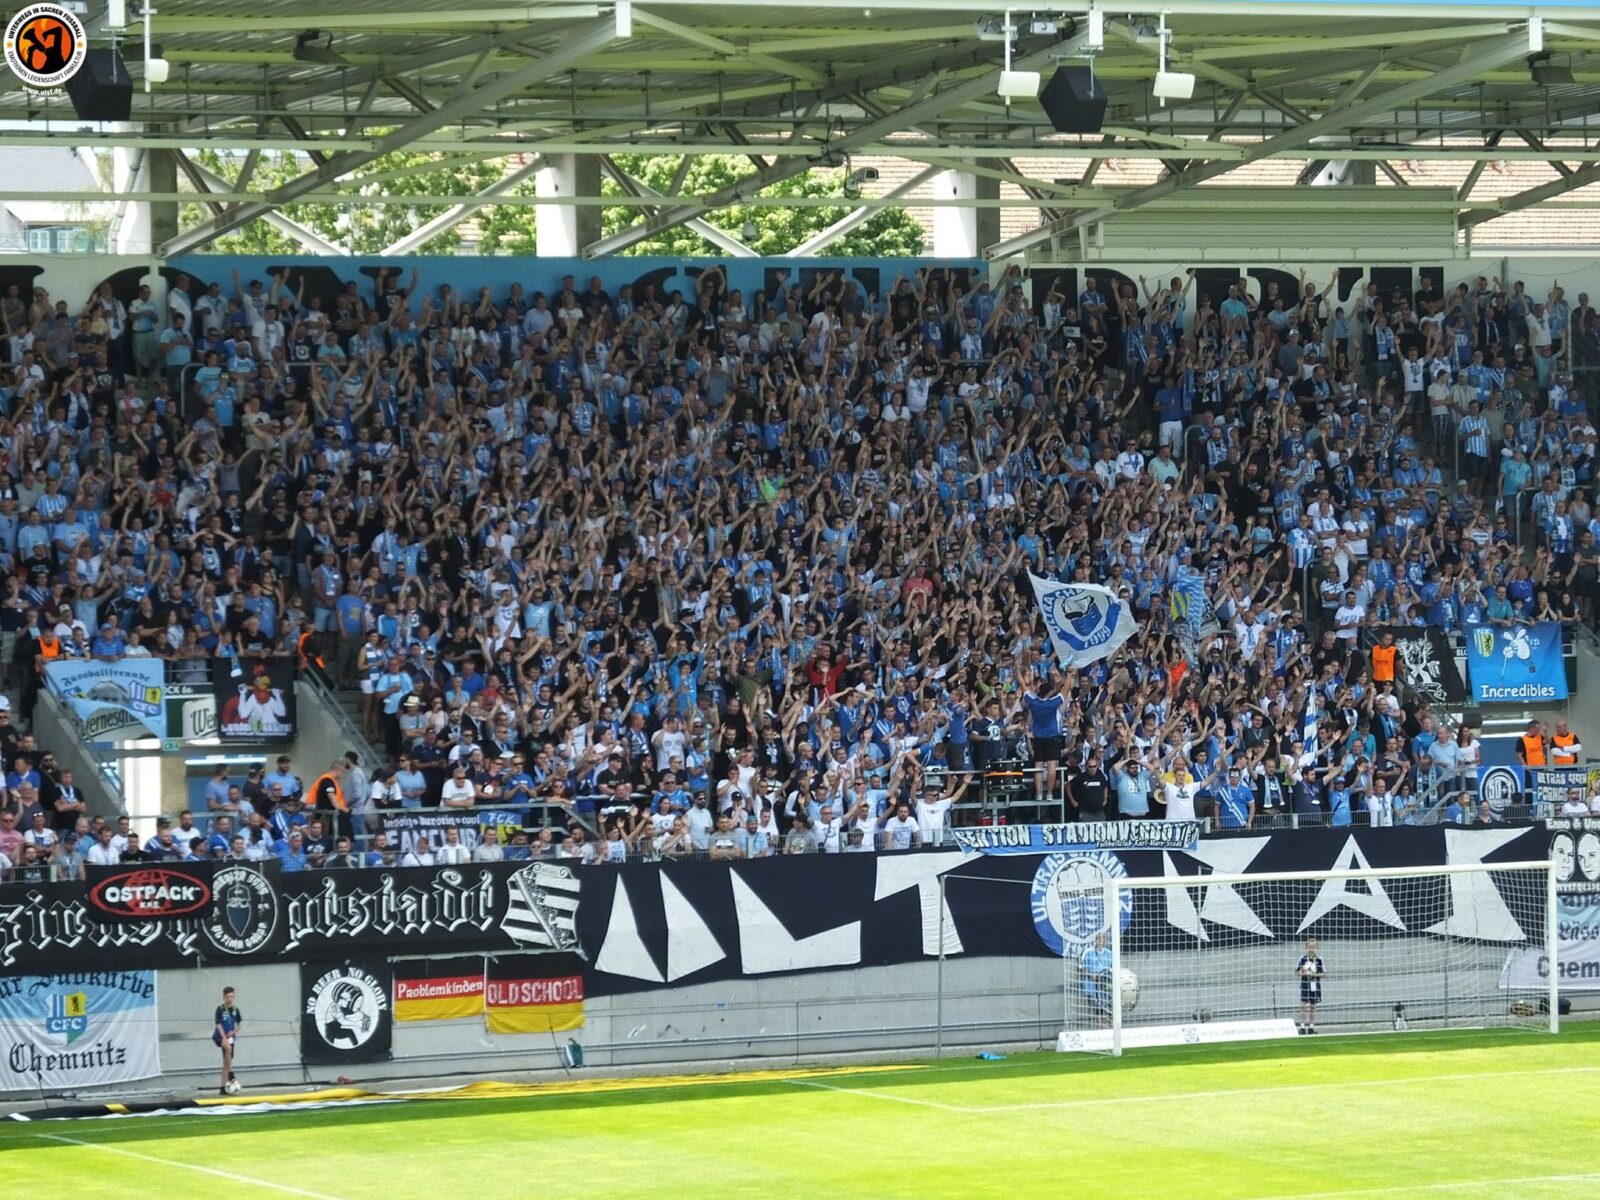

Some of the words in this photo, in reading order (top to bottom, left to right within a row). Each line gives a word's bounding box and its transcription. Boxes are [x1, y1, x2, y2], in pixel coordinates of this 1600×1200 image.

[1480, 683, 1556, 698] Incredibles
[132, 701, 157, 714] CFC
[956, 825, 1032, 850] SEKTION
[105, 885, 196, 902] OSTPACK
[1537, 955, 1600, 978] Cem
[306, 995, 318, 1015] NO
[312, 968, 342, 996] BEER
[347, 967, 364, 979] NO
[363, 974, 388, 1012] GLORY
[487, 983, 519, 1005] OLD
[519, 978, 584, 1003] SCHOOL
[50, 1017, 83, 1032] CFC
[9, 1039, 127, 1074] Chemnitz
